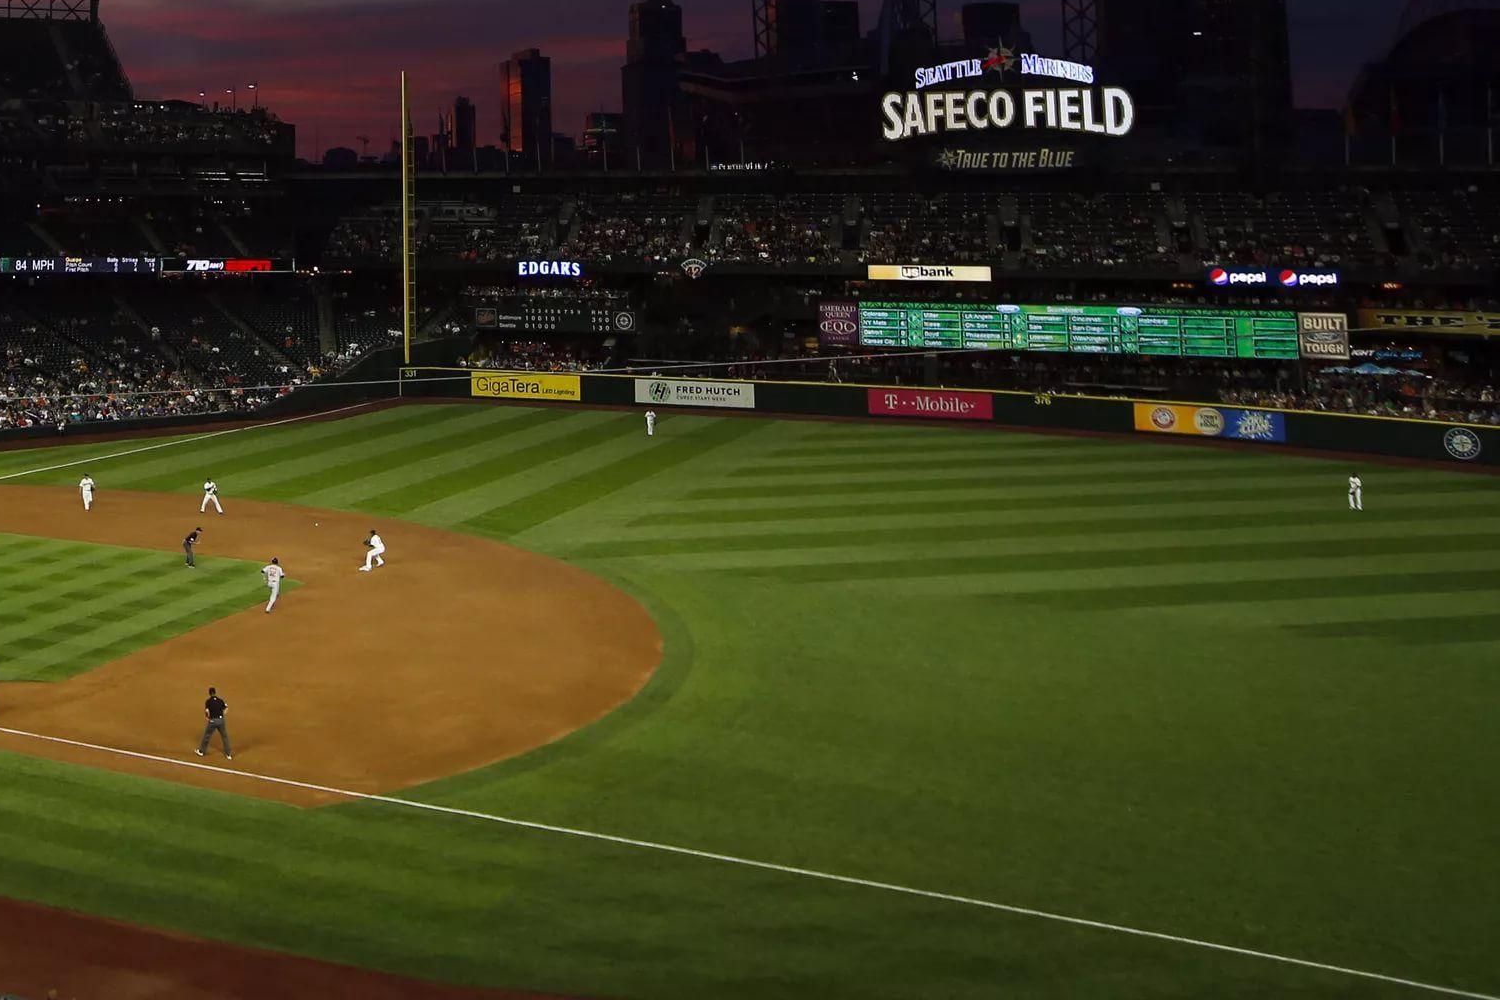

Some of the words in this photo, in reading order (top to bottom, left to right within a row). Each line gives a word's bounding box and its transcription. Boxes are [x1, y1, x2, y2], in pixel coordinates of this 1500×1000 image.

[915, 59, 982, 88] SEATTLE
[1021, 53, 1093, 84] MARINERS
[881, 89, 1015, 140] SAFECO
[1023, 86, 1135, 136] FIELD
[956, 150, 989, 168] TRUE
[992, 152, 1008, 168] TO
[1012, 152, 1036, 168] THE
[1038, 148, 1074, 168] BLUE
[15, 260, 27, 271] 84
[32, 260, 55, 271] MPH
[1229, 272, 1267, 285] pepsi
[1299, 273, 1337, 286] pepsi
[1303, 318, 1342, 330] BUILT
[1305, 343, 1344, 354] TOUGH
[404, 370, 417, 378] 331
[476, 376, 540, 396] GigaTera
[676, 386, 702, 394] FRED
[706, 387, 740, 396] HUTCH
